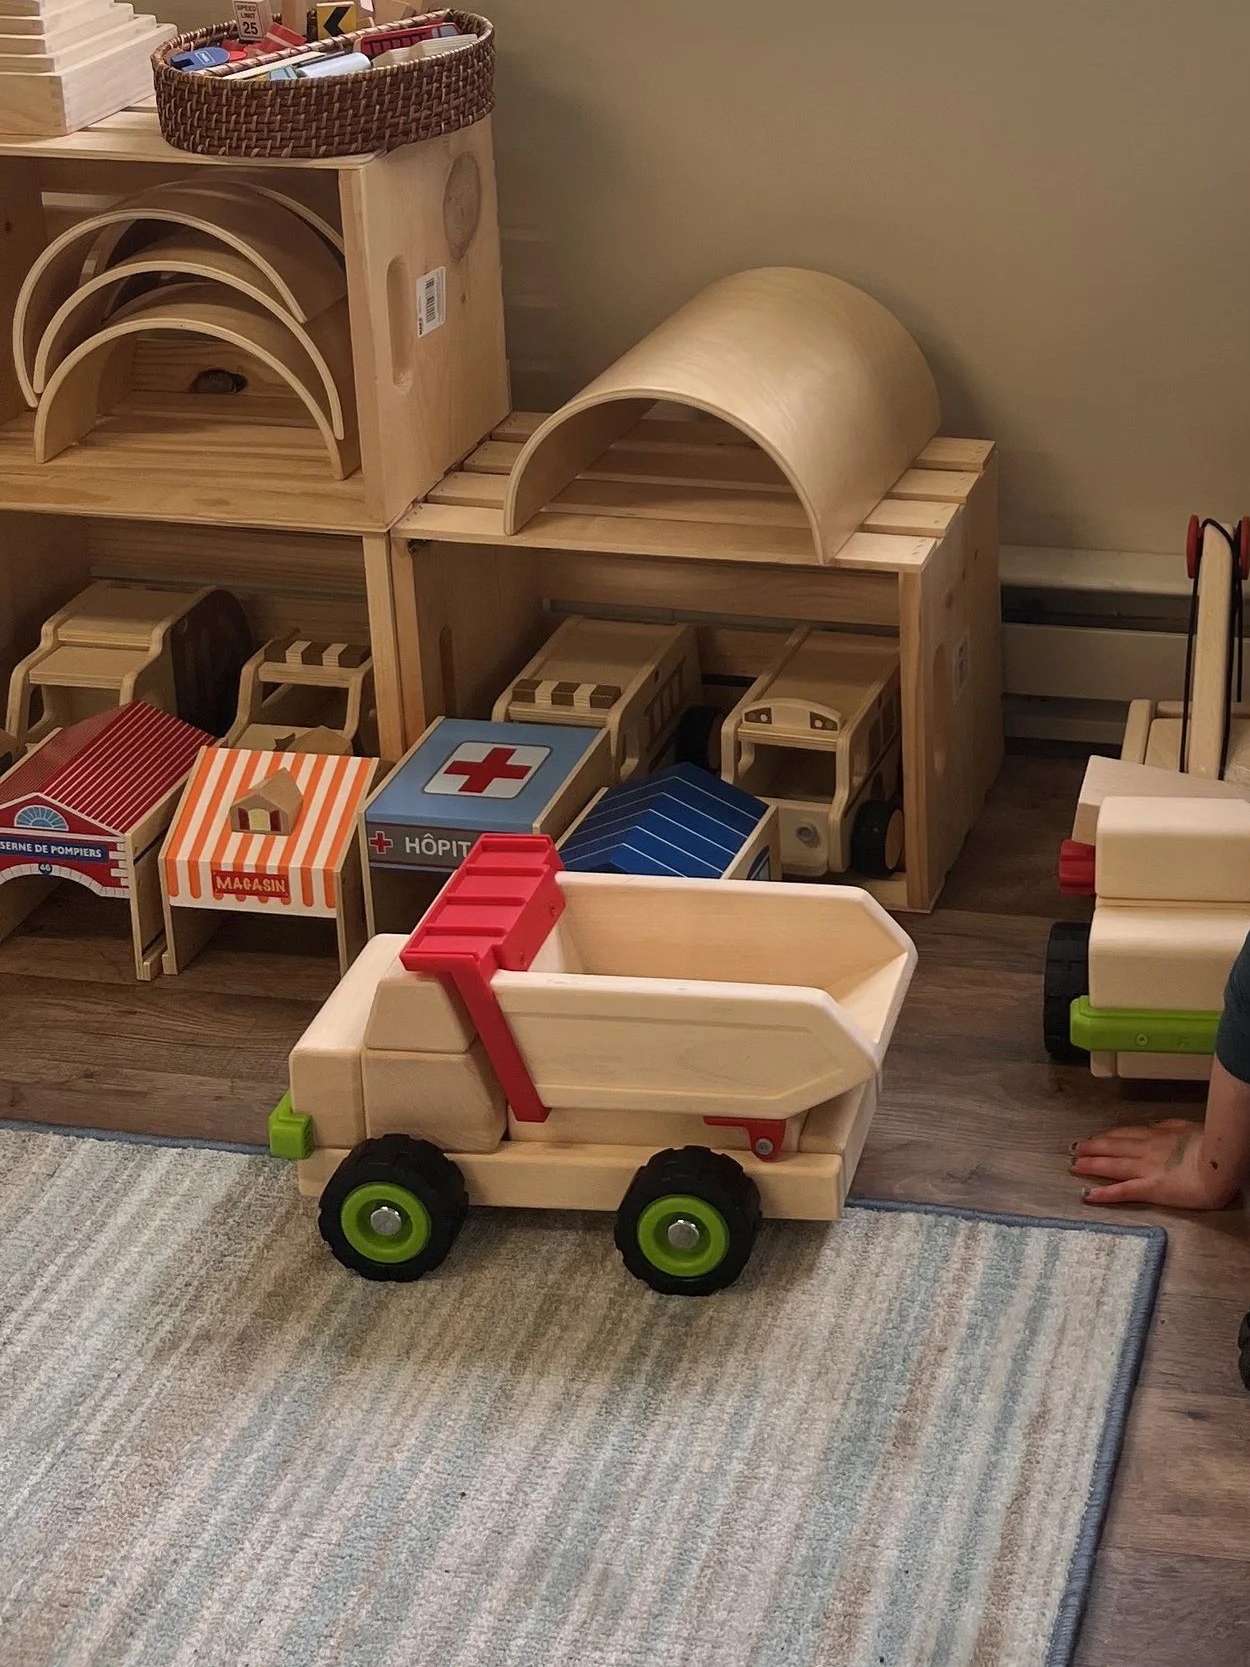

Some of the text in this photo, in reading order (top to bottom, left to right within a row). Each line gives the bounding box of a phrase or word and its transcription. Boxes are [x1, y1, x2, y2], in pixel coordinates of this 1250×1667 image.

[243, 21, 258, 35] 25
[34, 844, 49, 854] DE
[50, 845, 102, 858] POMPIERS
[216, 876, 286, 892] MAGASIN
